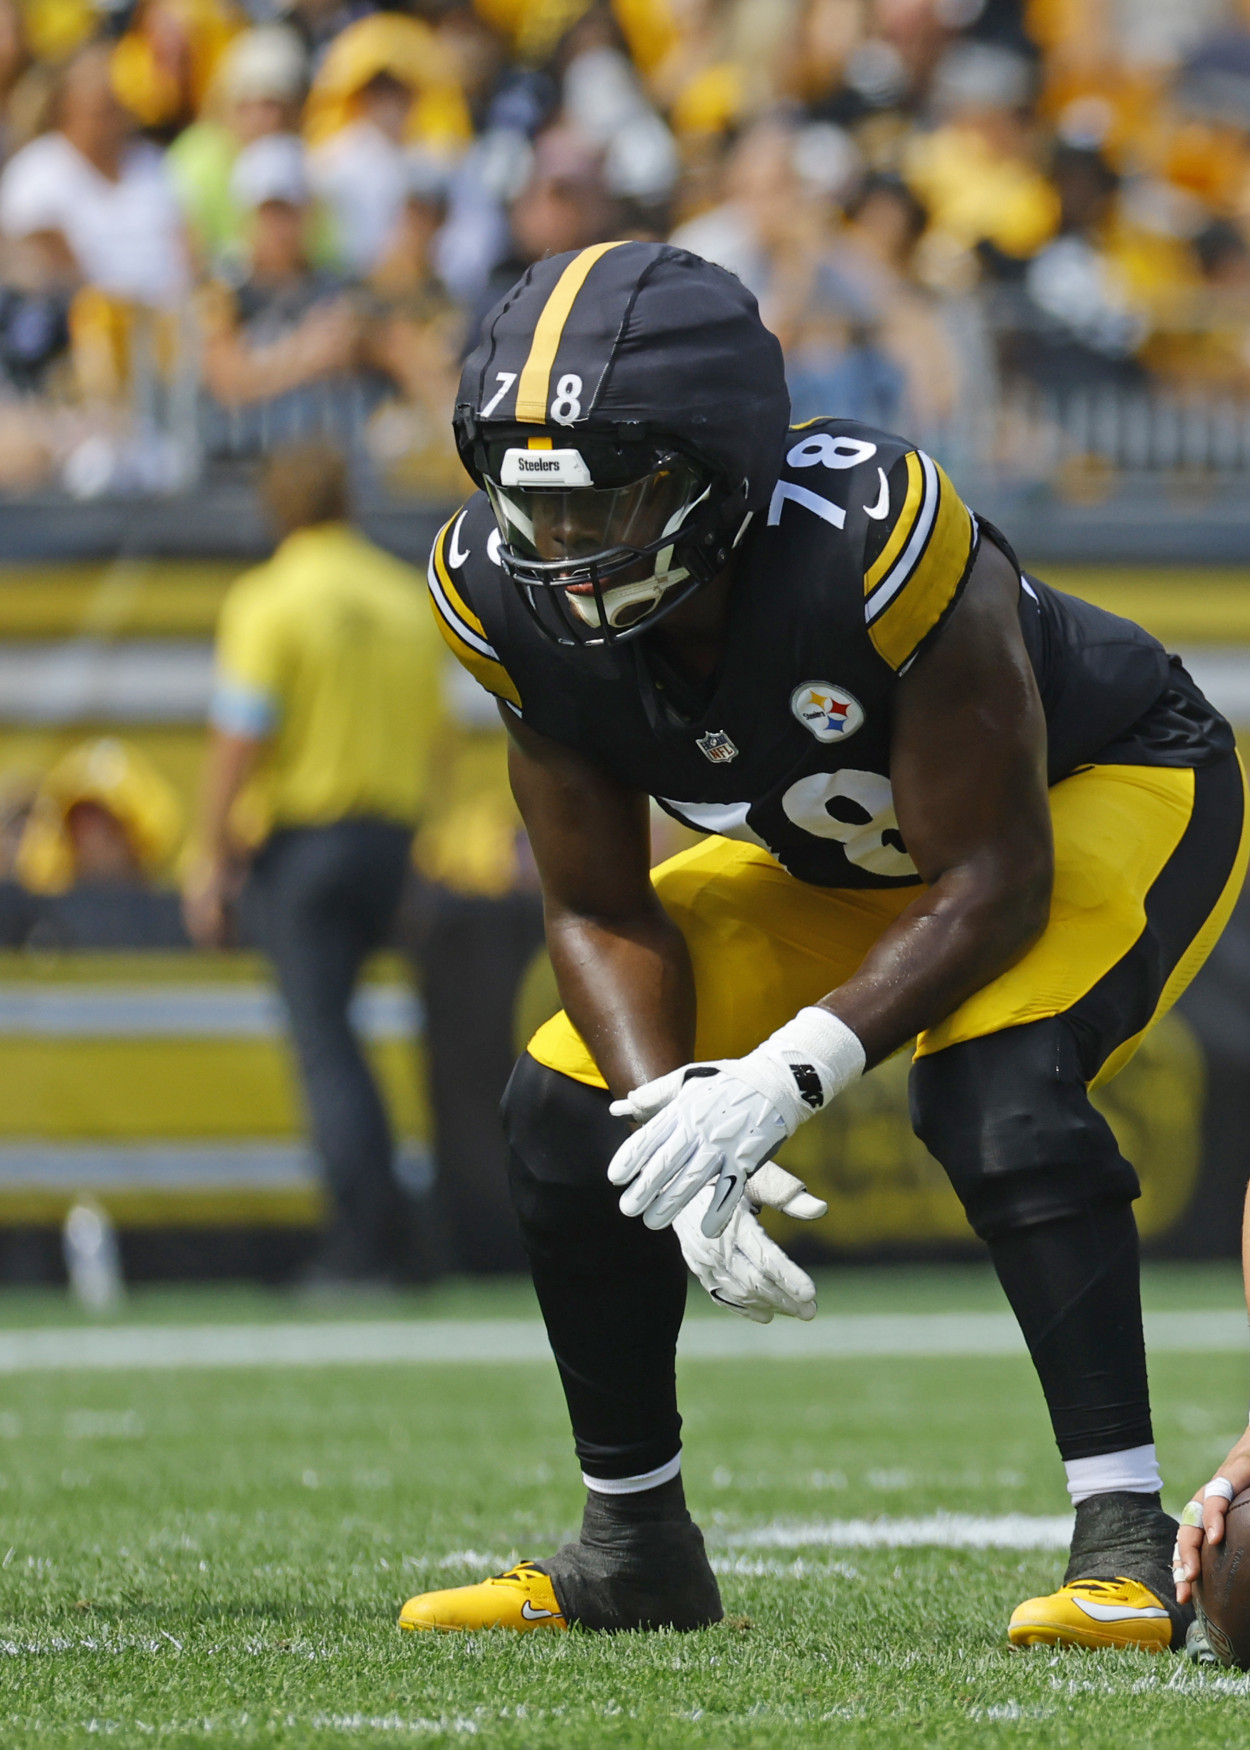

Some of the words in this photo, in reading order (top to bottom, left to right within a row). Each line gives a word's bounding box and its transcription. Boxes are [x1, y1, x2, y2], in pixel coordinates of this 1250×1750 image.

[518, 457, 560, 471] Steelers
[767, 433, 877, 530] 78
[710, 746, 733, 759] NFL
